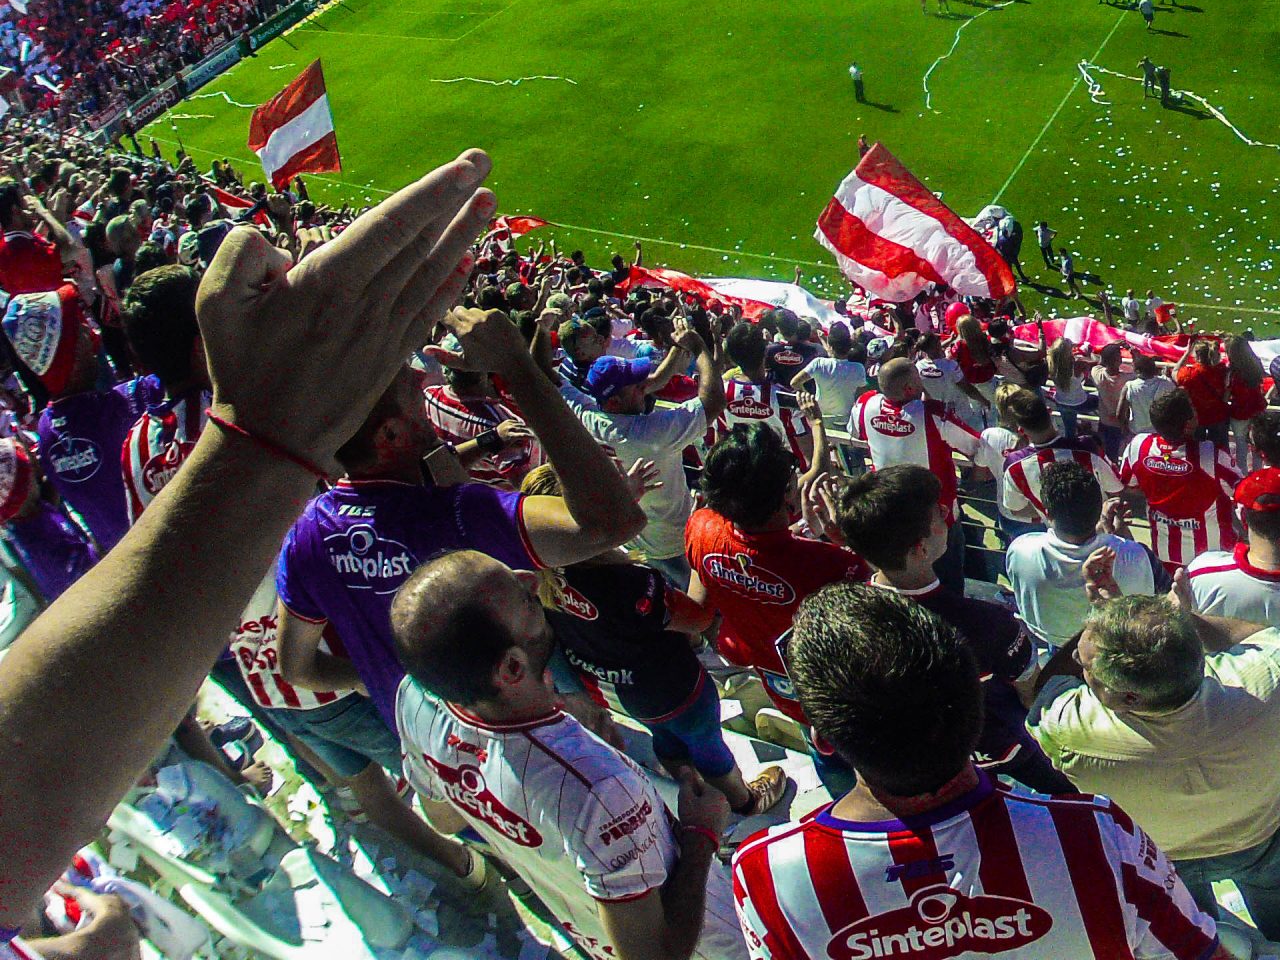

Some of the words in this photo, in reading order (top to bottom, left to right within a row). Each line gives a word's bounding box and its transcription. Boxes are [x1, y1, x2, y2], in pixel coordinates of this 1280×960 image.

[730, 403, 770, 417] Sinteplast
[872, 417, 912, 434] Sinteplast
[338, 504, 376, 517] TBS
[711, 559, 785, 598] Sinteplast
[846, 907, 1033, 960] Sinteplast
